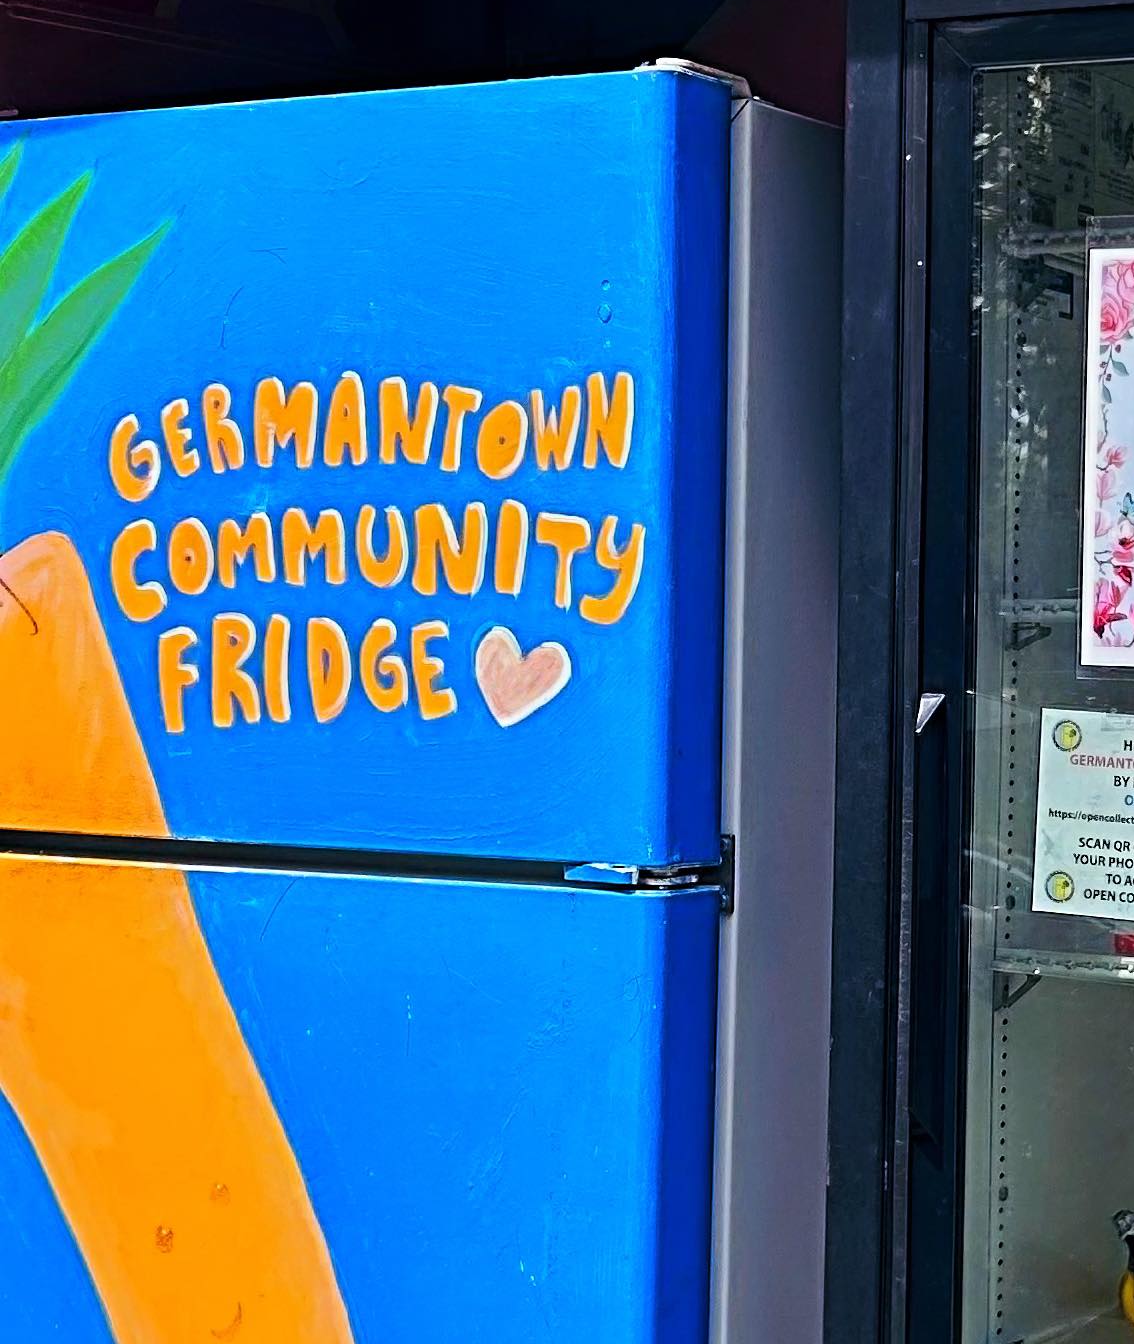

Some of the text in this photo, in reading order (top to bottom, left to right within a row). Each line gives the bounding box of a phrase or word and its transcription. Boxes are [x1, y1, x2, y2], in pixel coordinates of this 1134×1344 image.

[108, 370, 635, 503] GERMANTOWN
[111, 498, 645, 626] COMMUNITY
[158, 613, 459, 735] FRIDGE
[1113, 776, 1131, 788] BY
[1078, 837, 1111, 851] SCAN
[1113, 840, 1132, 854] QR
[1073, 853, 1107, 867] YOUR
[1105, 873, 1123, 886] TO
[1083, 888, 1117, 904] OPEN
